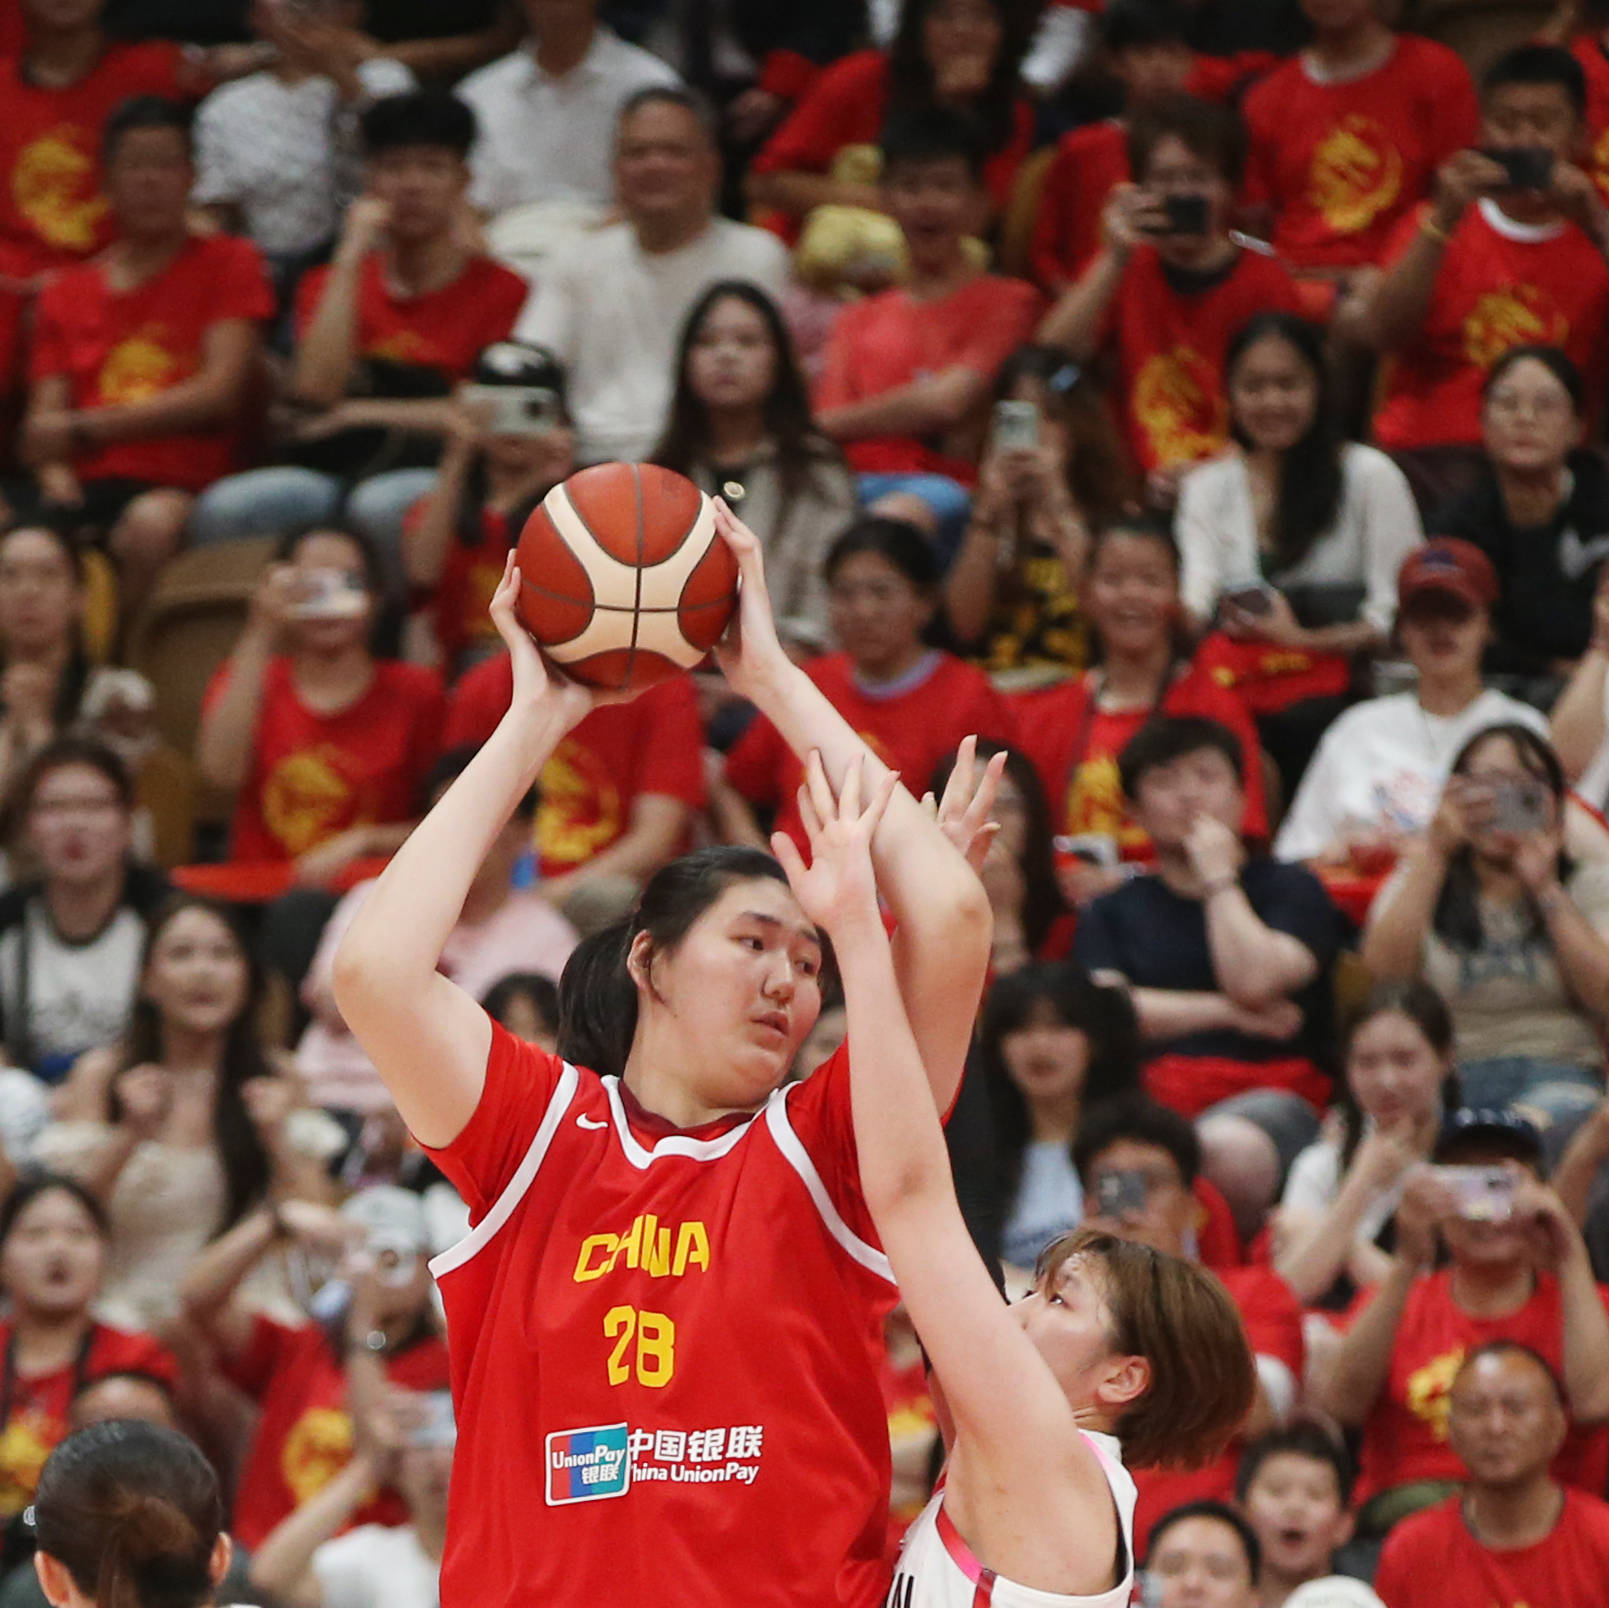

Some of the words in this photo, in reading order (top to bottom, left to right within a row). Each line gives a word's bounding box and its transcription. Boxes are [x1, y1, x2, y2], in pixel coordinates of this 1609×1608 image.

[573, 1214, 710, 1283] CHINA
[603, 1304, 675, 1388] 28
[552, 1444, 626, 1470] UnionPay
[627, 1426, 763, 1463] 中国银联
[581, 1464, 620, 1484] 银联
[631, 1463, 668, 1482] hina
[670, 1461, 759, 1484] UnionPay
